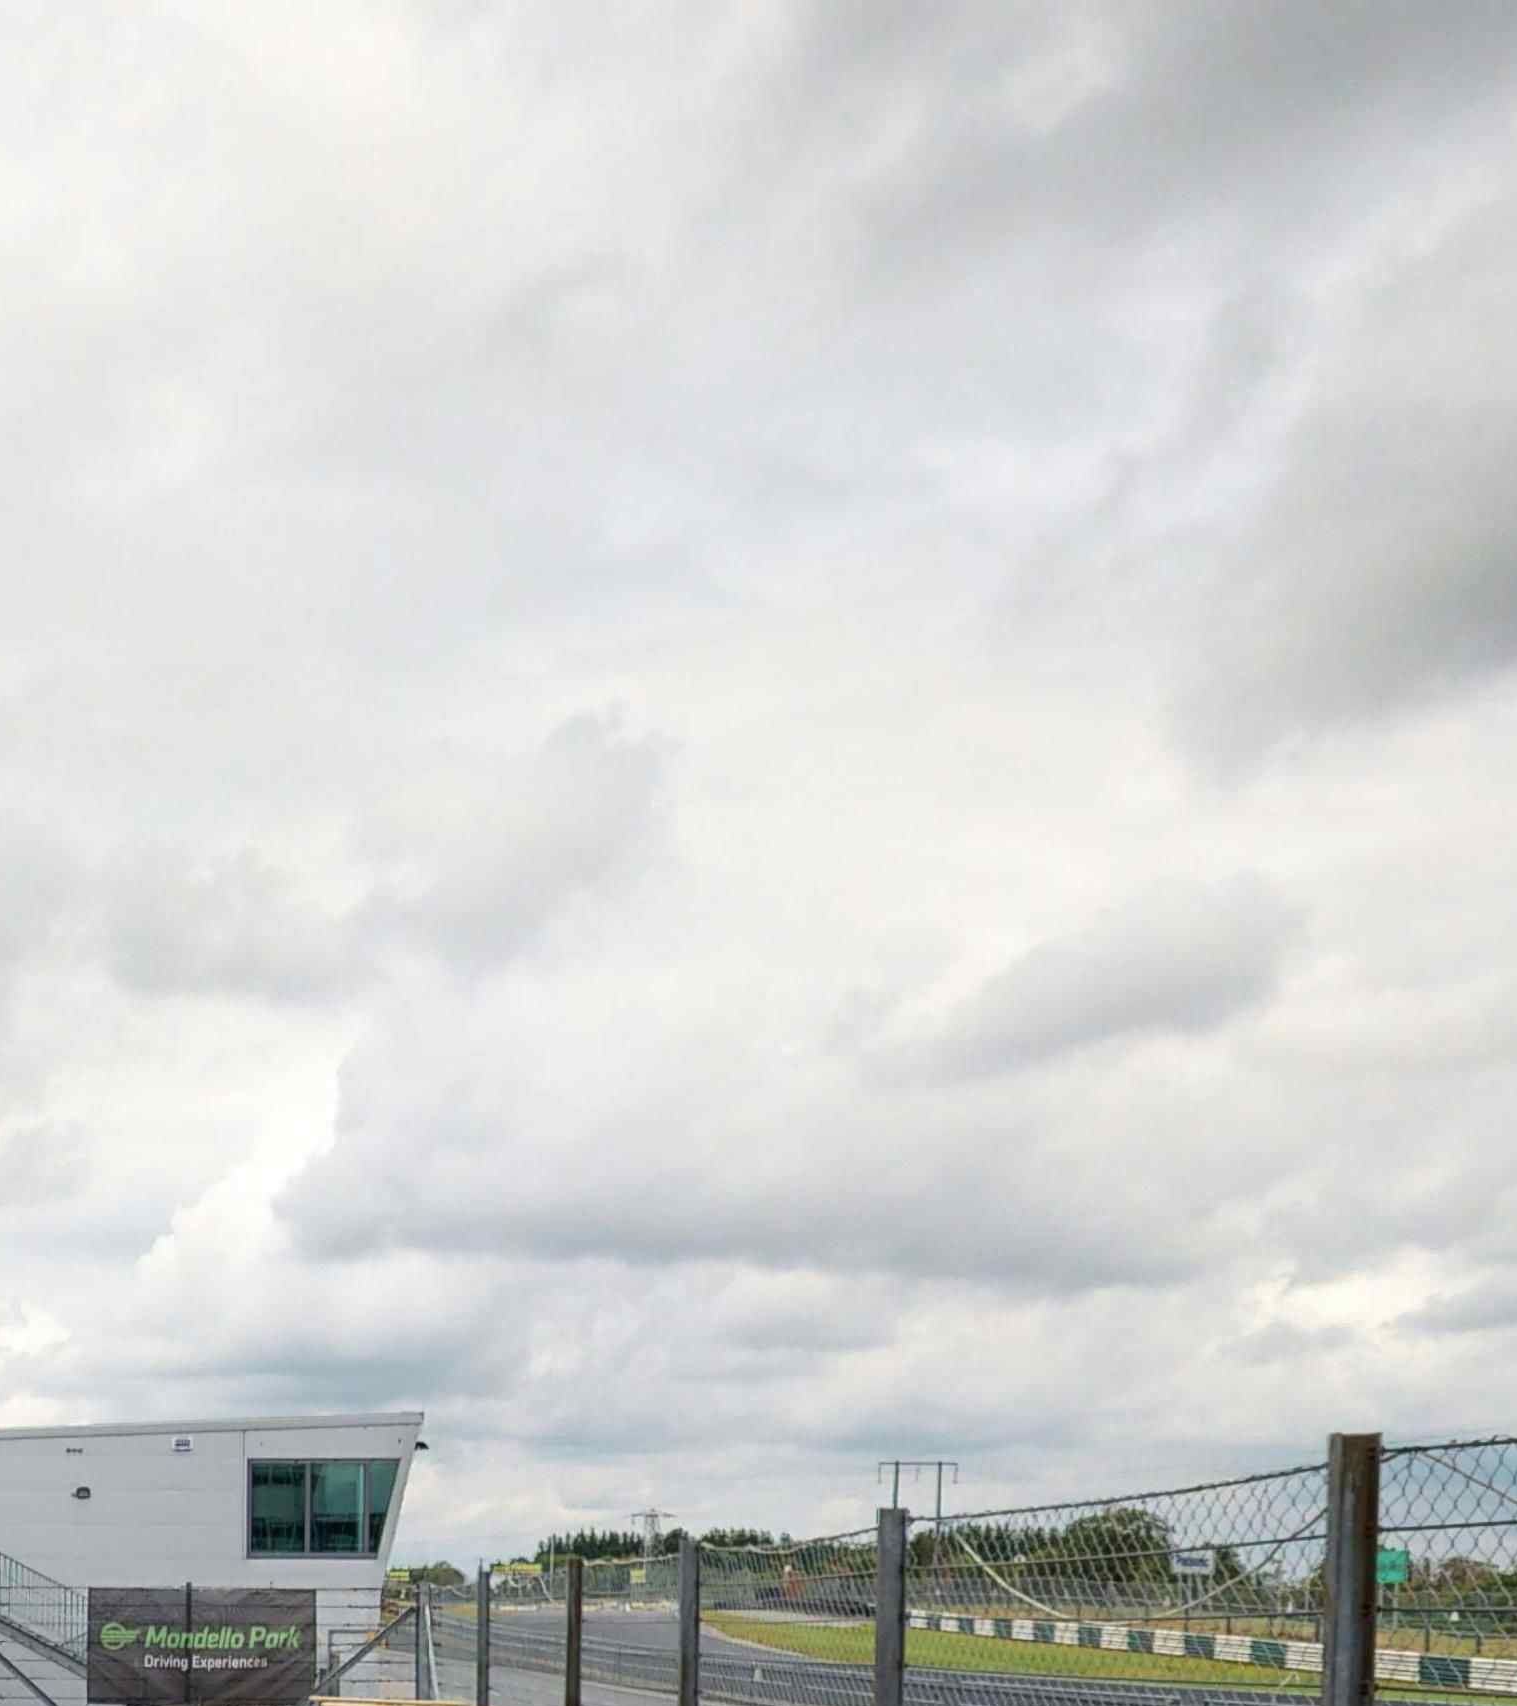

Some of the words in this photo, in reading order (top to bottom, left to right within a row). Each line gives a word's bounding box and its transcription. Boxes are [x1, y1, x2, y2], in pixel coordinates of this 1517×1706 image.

[145, 1625, 245, 1650] Mondello
[249, 1625, 303, 1650] Park
[144, 1654, 189, 1672] Driving
[192, 1655, 269, 1673] Experiences
